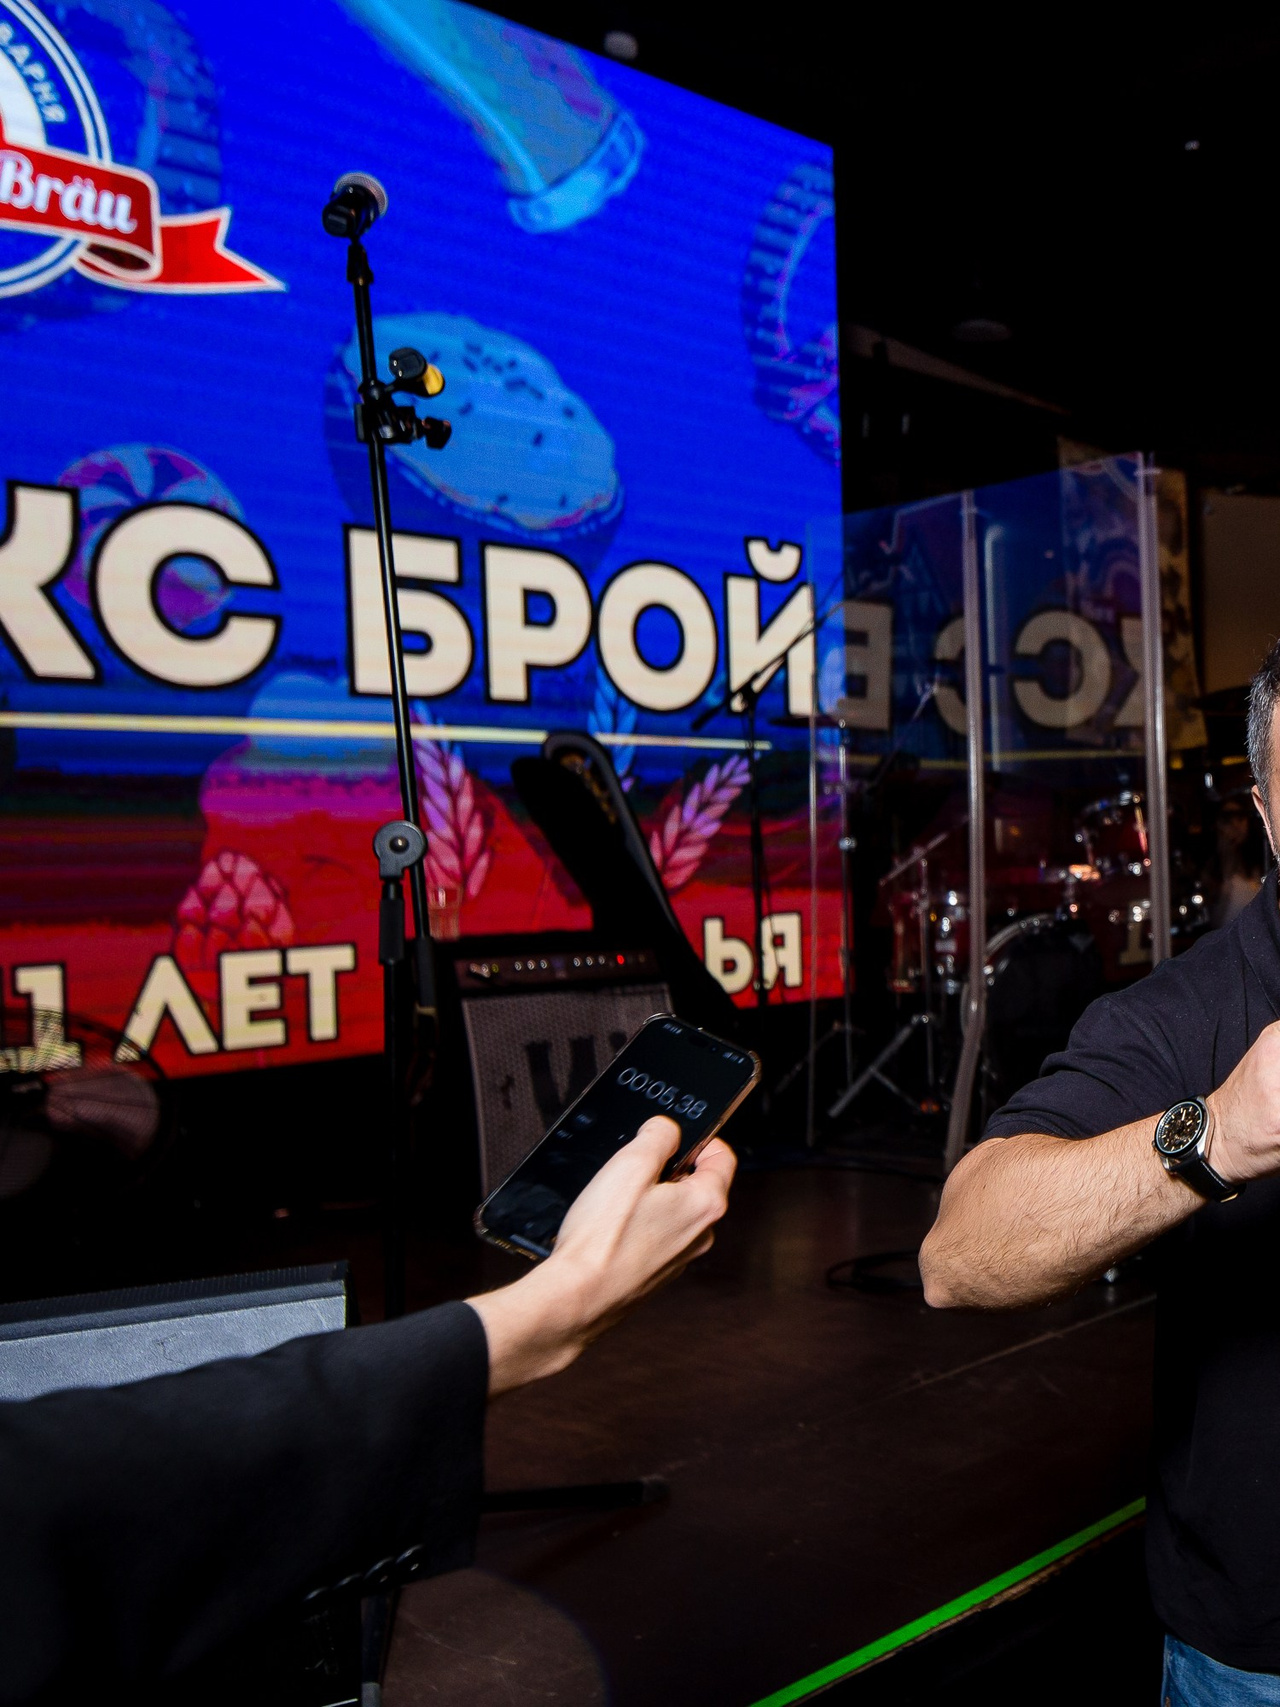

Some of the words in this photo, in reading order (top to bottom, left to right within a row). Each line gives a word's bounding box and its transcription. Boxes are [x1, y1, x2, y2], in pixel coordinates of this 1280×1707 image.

[0, 152, 138, 234] Bräu
[347, 527, 815, 715] БРОЙ
[113, 944, 356, 1063] ЛЕТ
